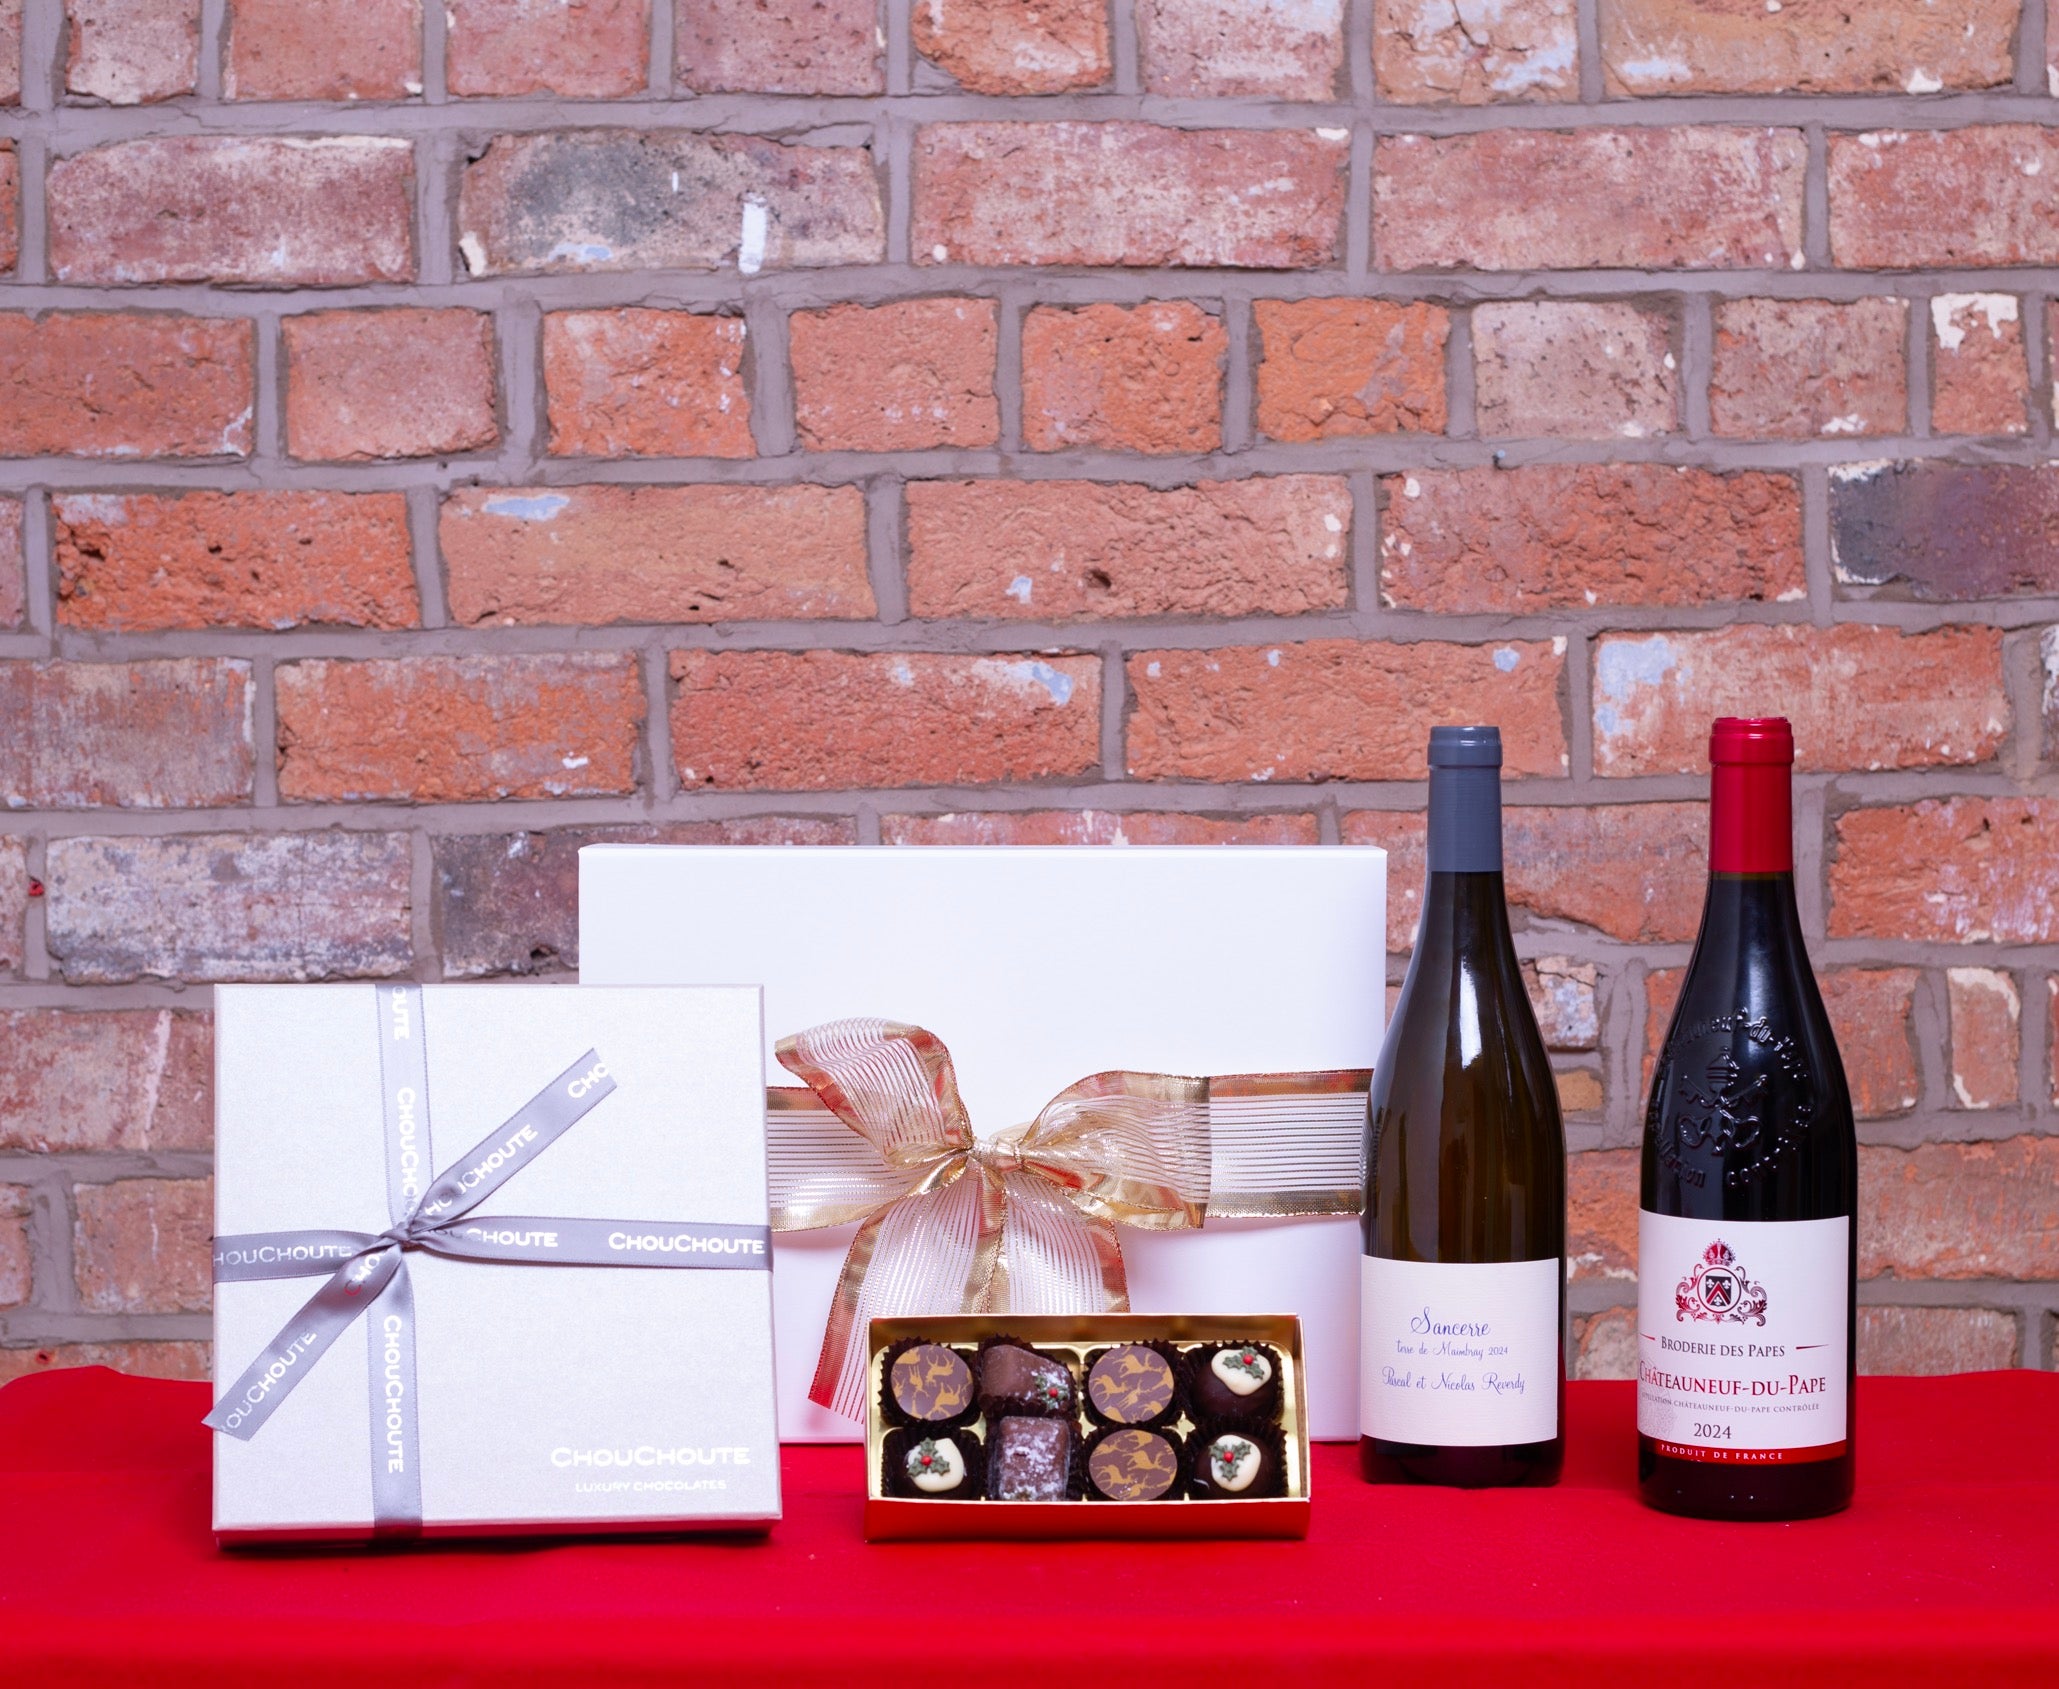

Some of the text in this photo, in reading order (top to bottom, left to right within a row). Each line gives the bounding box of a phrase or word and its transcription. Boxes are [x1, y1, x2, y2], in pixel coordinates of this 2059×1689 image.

[608, 1232, 765, 1254] CHOUCHOUTE
[1410, 1306, 1491, 1337] Sancerre
[1488, 1346, 1508, 1355] 2024
[1661, 1336, 1785, 1357] BRODERIE DES PAPES
[221, 1332, 317, 1431] OUCHOUTE
[1382, 1366, 1525, 1395] Pascal et Nicolas Reverdy
[383, 1314, 404, 1474] CHOUCHOUTE
[1694, 1423, 1732, 1439] 2024
[550, 1446, 751, 1468] CHOUCHOUTE
[1661, 1444, 1706, 1457] PRODUIT
[575, 1480, 727, 1493] LUXURY CHOCOLATES
